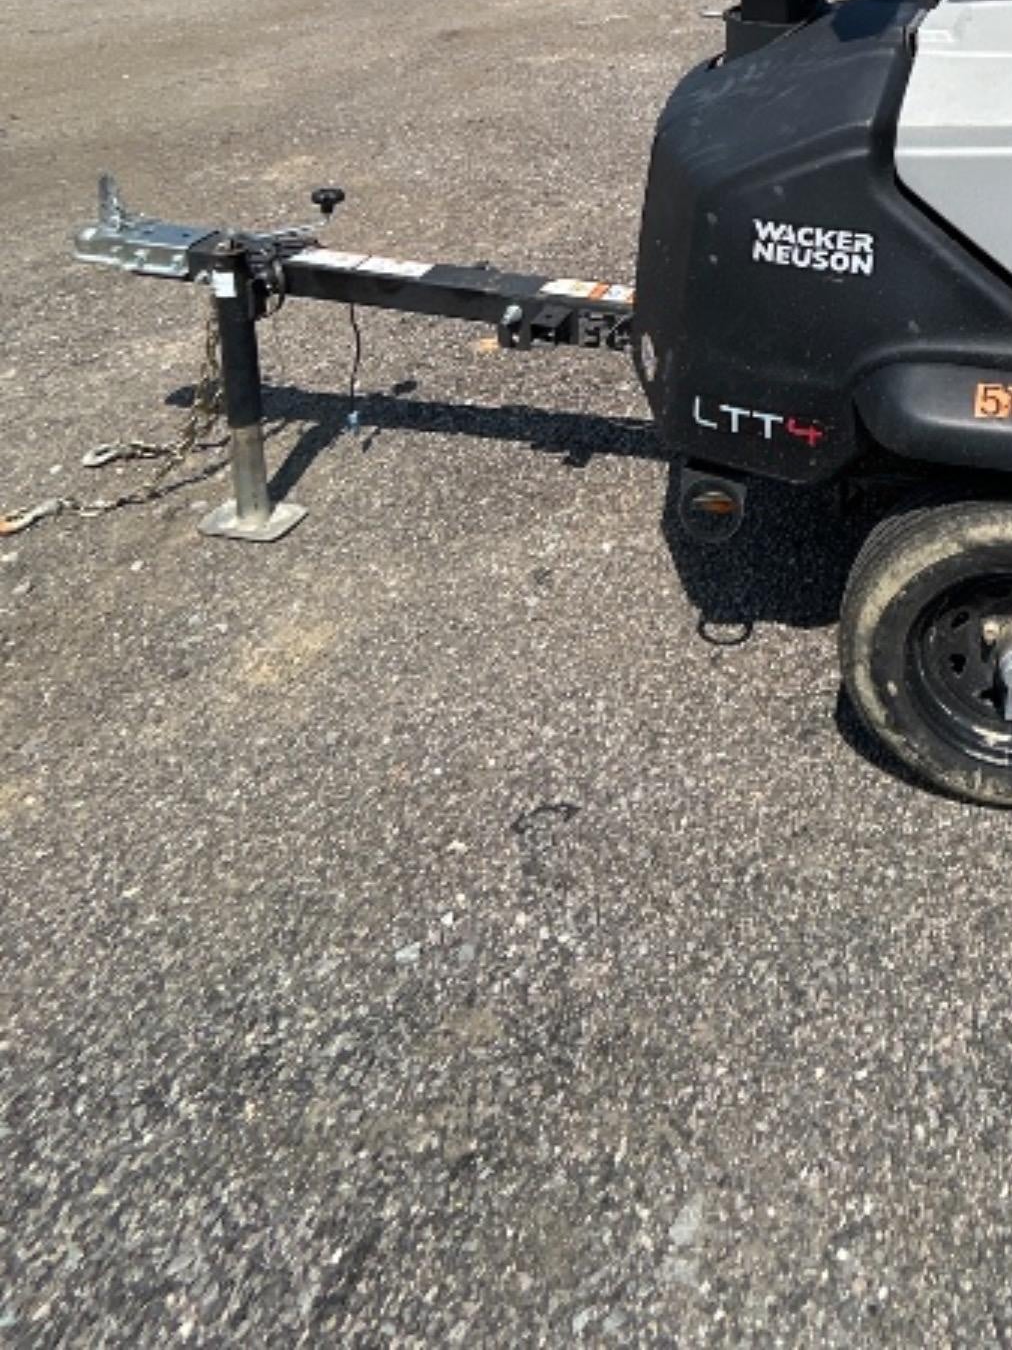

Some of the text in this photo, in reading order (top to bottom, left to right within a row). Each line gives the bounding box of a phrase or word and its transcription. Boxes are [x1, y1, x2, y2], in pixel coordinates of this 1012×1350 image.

[752, 218, 874, 253] WACKER
[752, 239, 874, 276] NEUSON
[692, 394, 823, 447] LTT4
